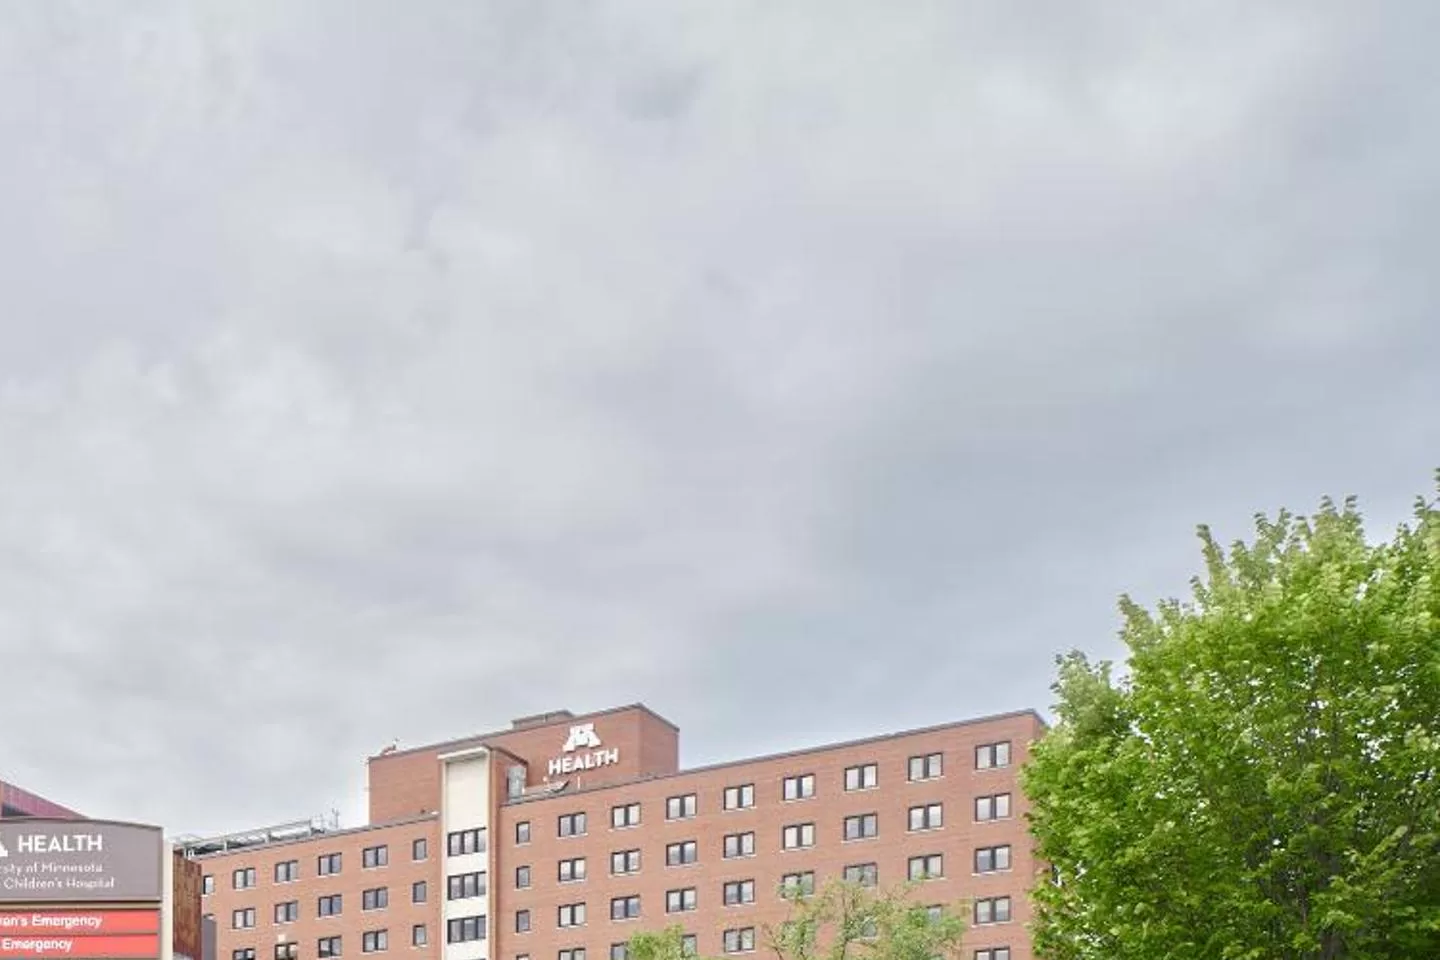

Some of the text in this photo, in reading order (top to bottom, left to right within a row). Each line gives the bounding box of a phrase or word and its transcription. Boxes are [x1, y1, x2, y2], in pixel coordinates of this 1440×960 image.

[549, 748, 619, 776] HEALTH
[18, 834, 103, 853] HEALTH
[26, 863, 38, 873] of
[41, 862, 103, 873] Minnesota
[3, 877, 62, 889] Children's
[66, 877, 115, 889] Hospital
[32, 915, 102, 928] Emergency
[2, 939, 73, 952] Emergency
